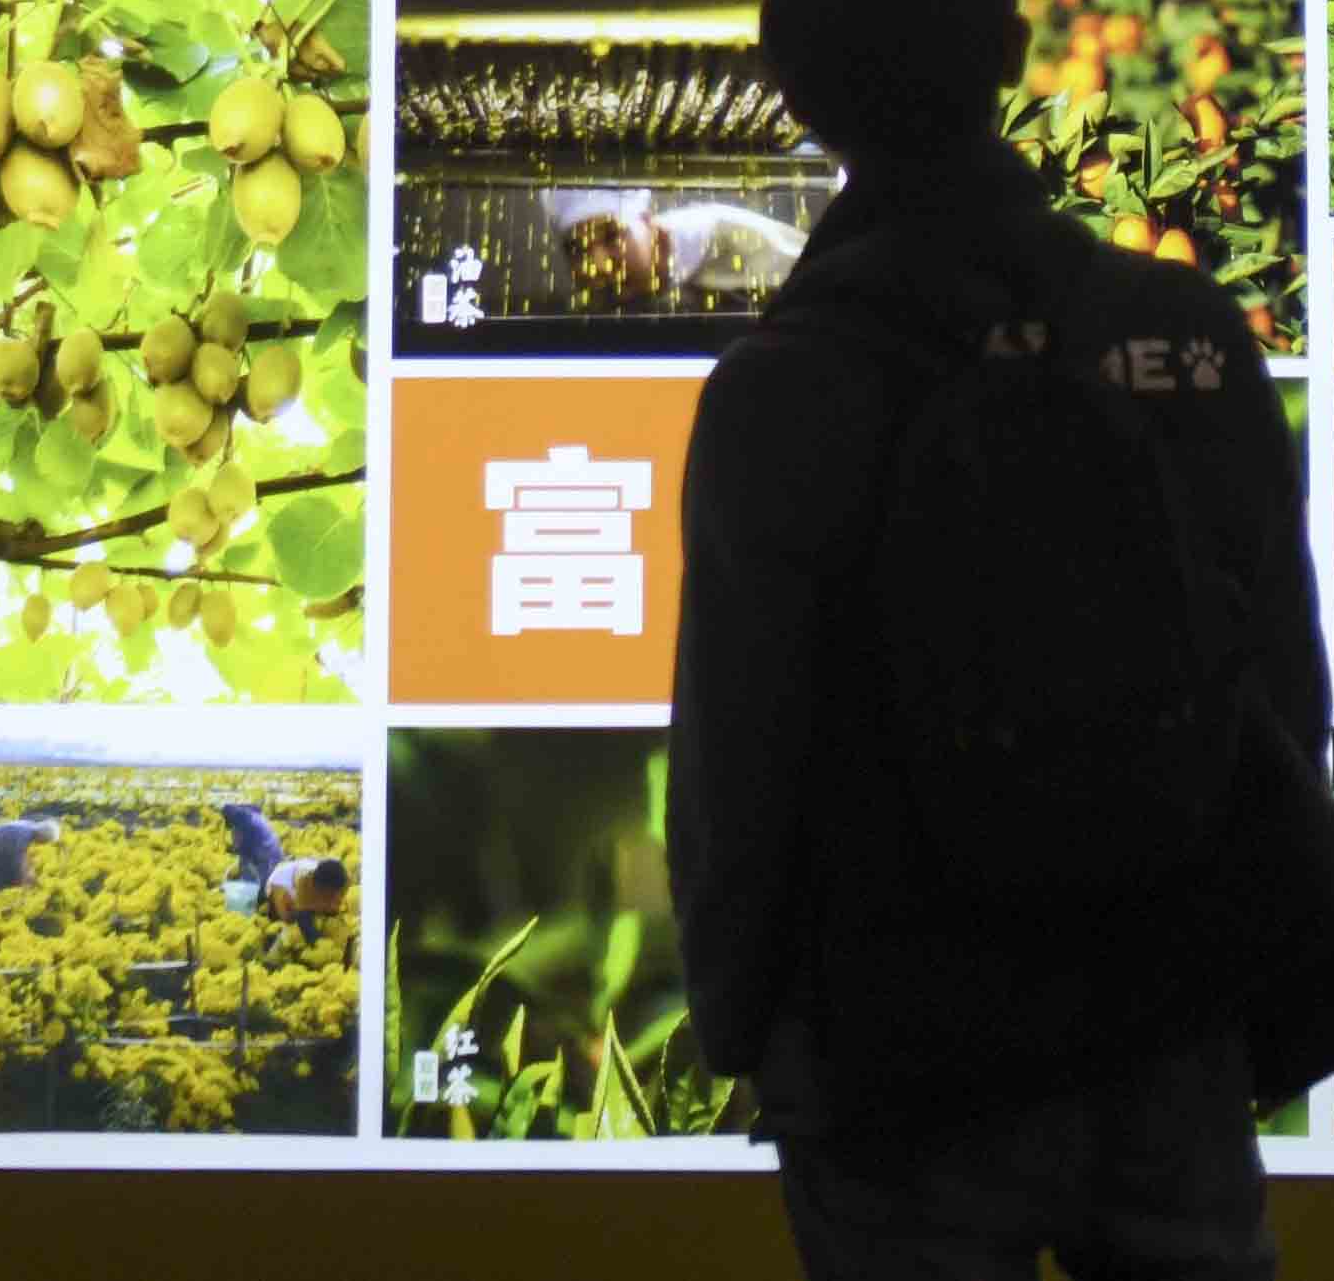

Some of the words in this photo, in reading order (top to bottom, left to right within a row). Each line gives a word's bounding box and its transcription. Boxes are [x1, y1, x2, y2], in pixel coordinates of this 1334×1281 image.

[448, 245, 486, 328] 油茶
[484, 445, 652, 636] 富
[443, 1022, 480, 1108] 红茶
